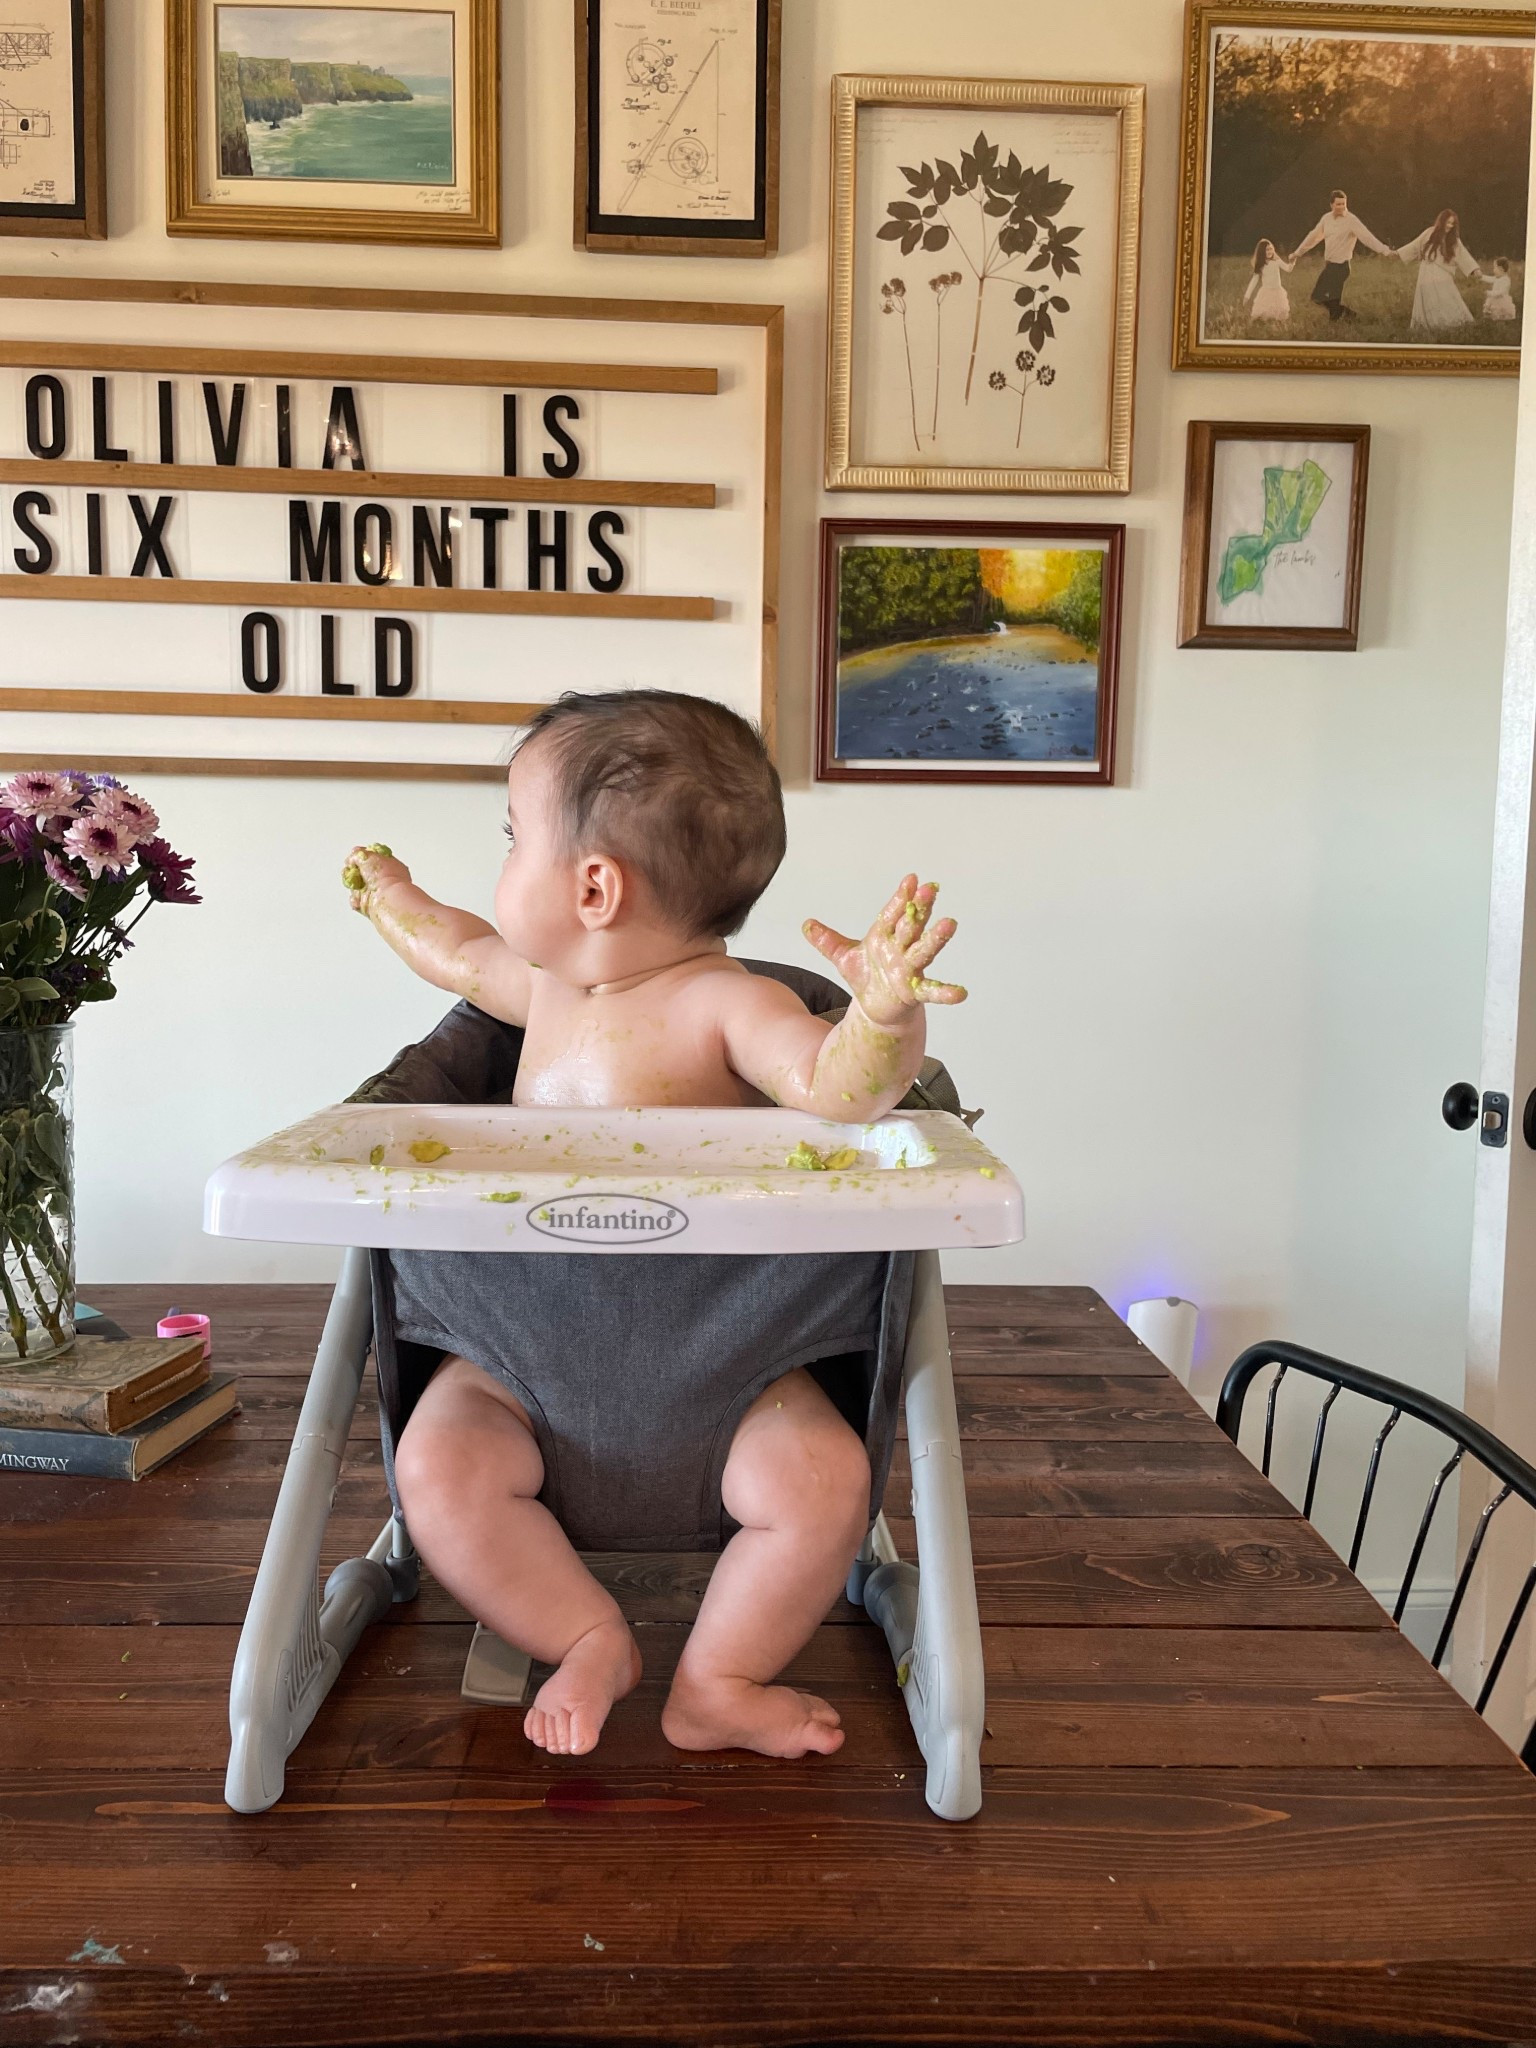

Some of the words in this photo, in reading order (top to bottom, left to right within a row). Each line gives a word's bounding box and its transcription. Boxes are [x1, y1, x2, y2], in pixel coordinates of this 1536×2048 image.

[25, 374, 365, 471] OLIVIA
[503, 393, 580, 478] IS
[12, 491, 174, 578] SIX
[289, 499, 625, 593] MONTHS
[241, 612, 414, 697] OLD
